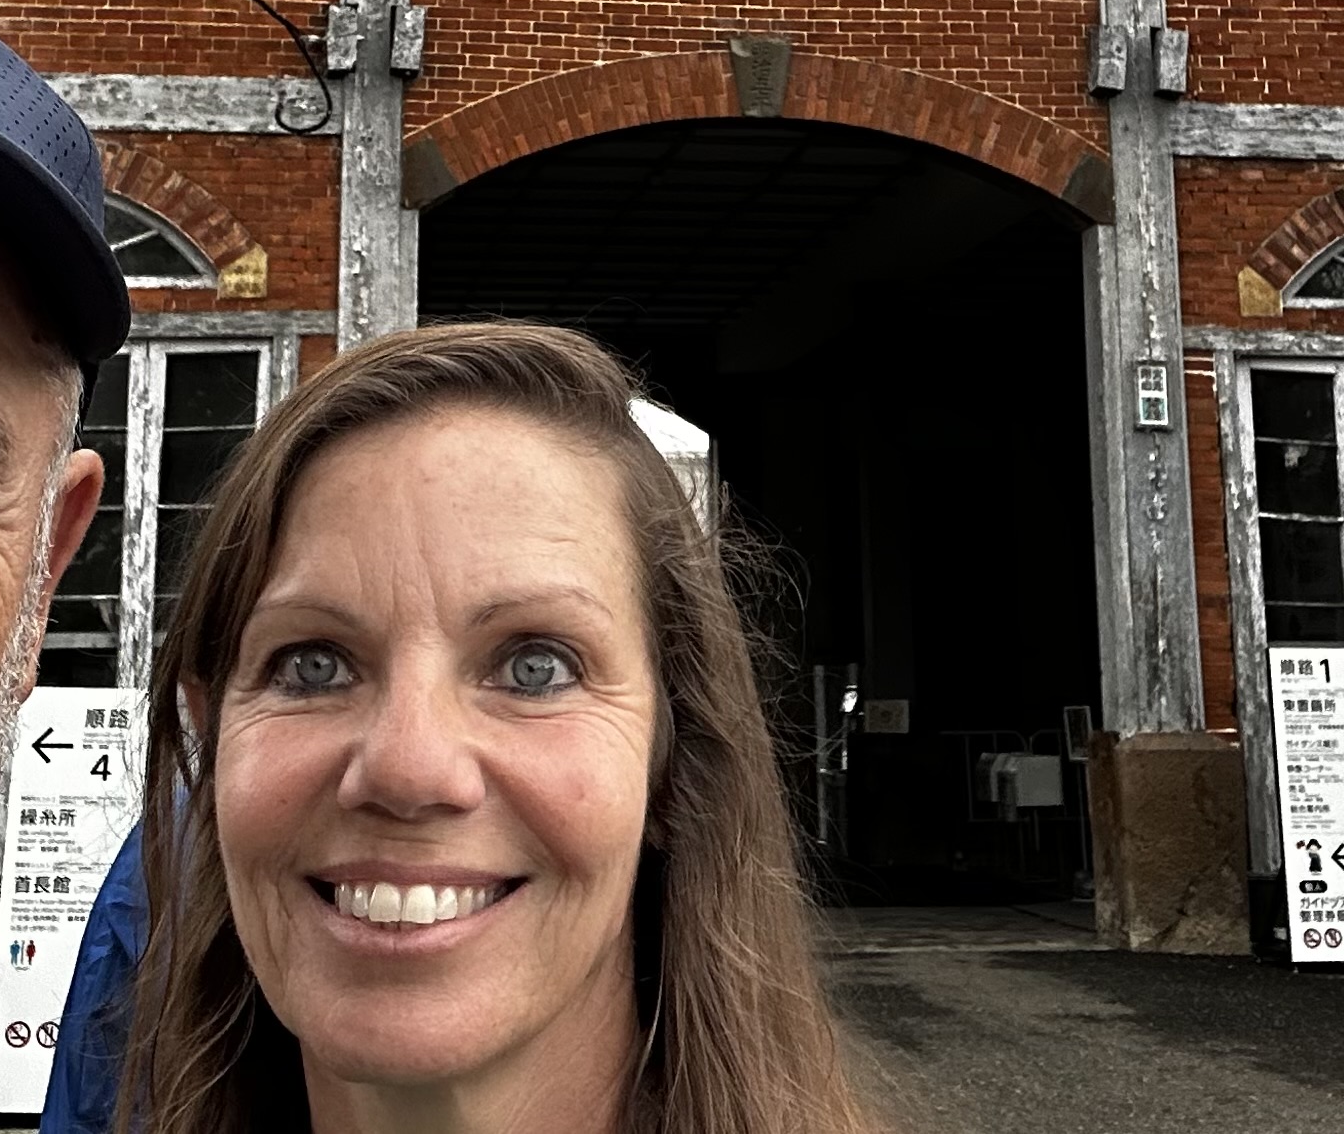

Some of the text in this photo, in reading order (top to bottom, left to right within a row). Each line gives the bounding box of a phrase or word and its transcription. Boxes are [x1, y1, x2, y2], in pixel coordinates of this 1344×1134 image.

[1320, 659, 1331, 683] 1
[85, 709, 129, 728] 順路
[90, 754, 112, 781] 4
[15, 875, 71, 894] 首長館
